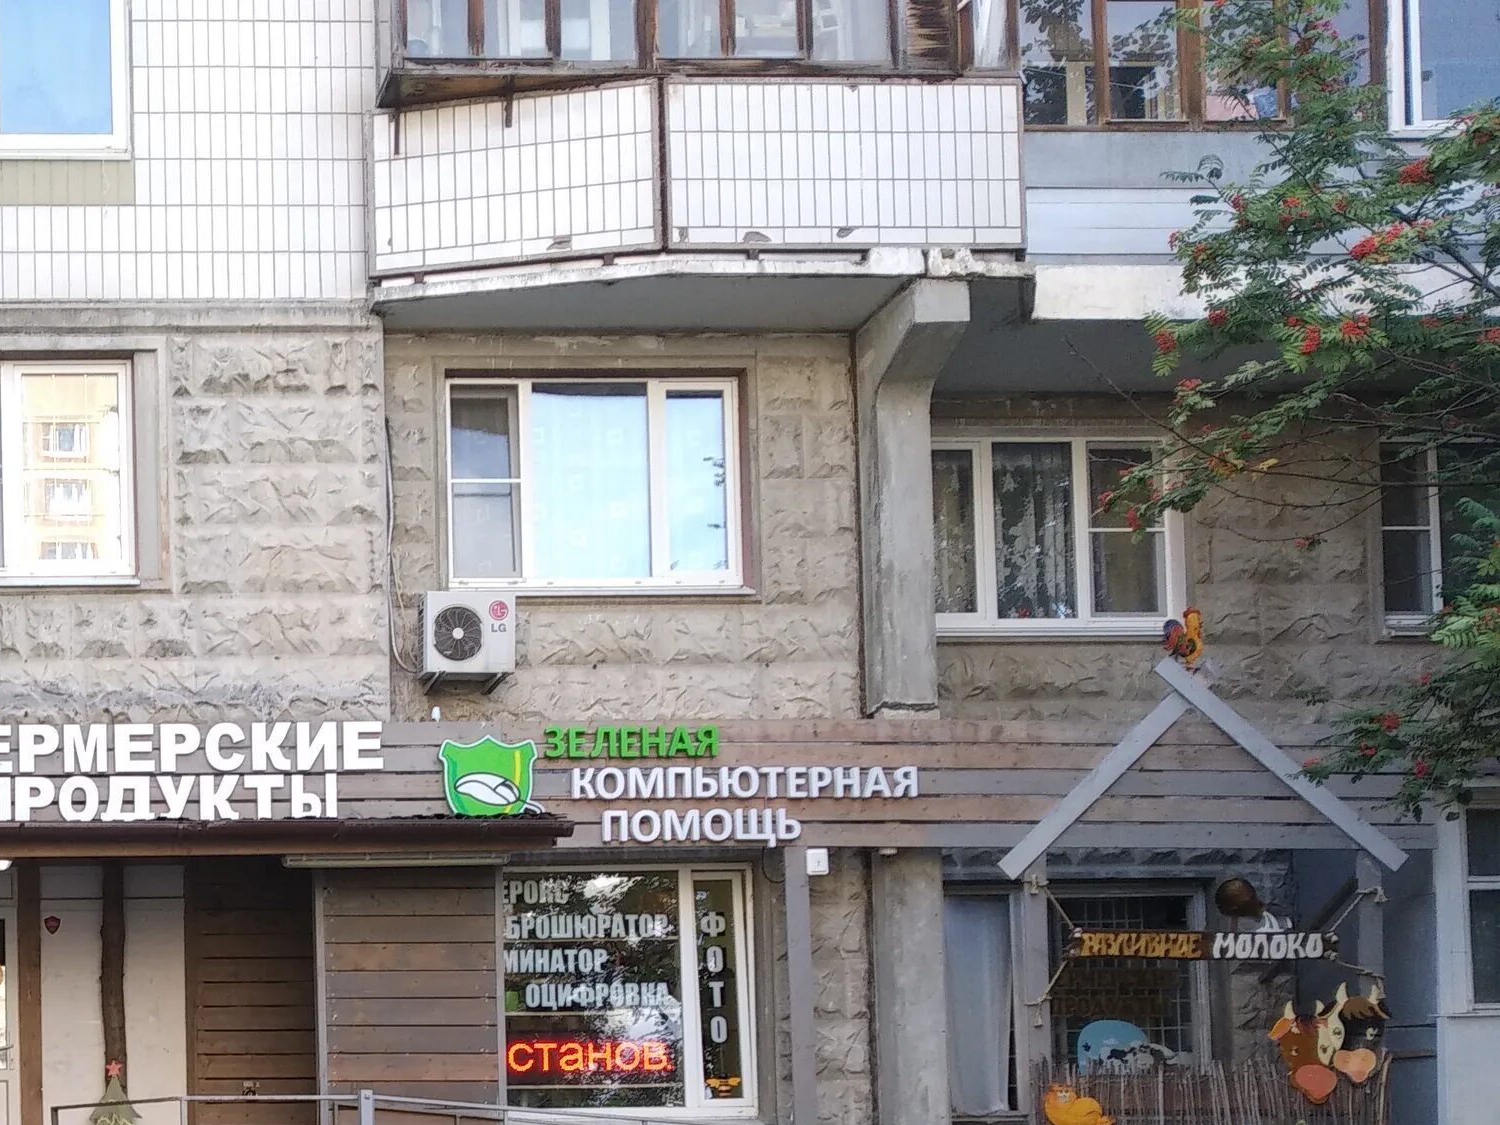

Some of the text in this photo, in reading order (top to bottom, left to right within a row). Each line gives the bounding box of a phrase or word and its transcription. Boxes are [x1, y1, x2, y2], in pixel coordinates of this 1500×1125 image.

[491, 623, 507, 632] LG
[543, 725, 721, 760] ЗЕЛЕНАЯ
[571, 764, 920, 800] КОМПЬЮТЕРНАЯ
[601, 807, 803, 848] ПОМОЩЬ
[1212, 931, 1324, 960] МОЛОКО
[525, 982, 669, 1010] ОЦИФРОВКА
